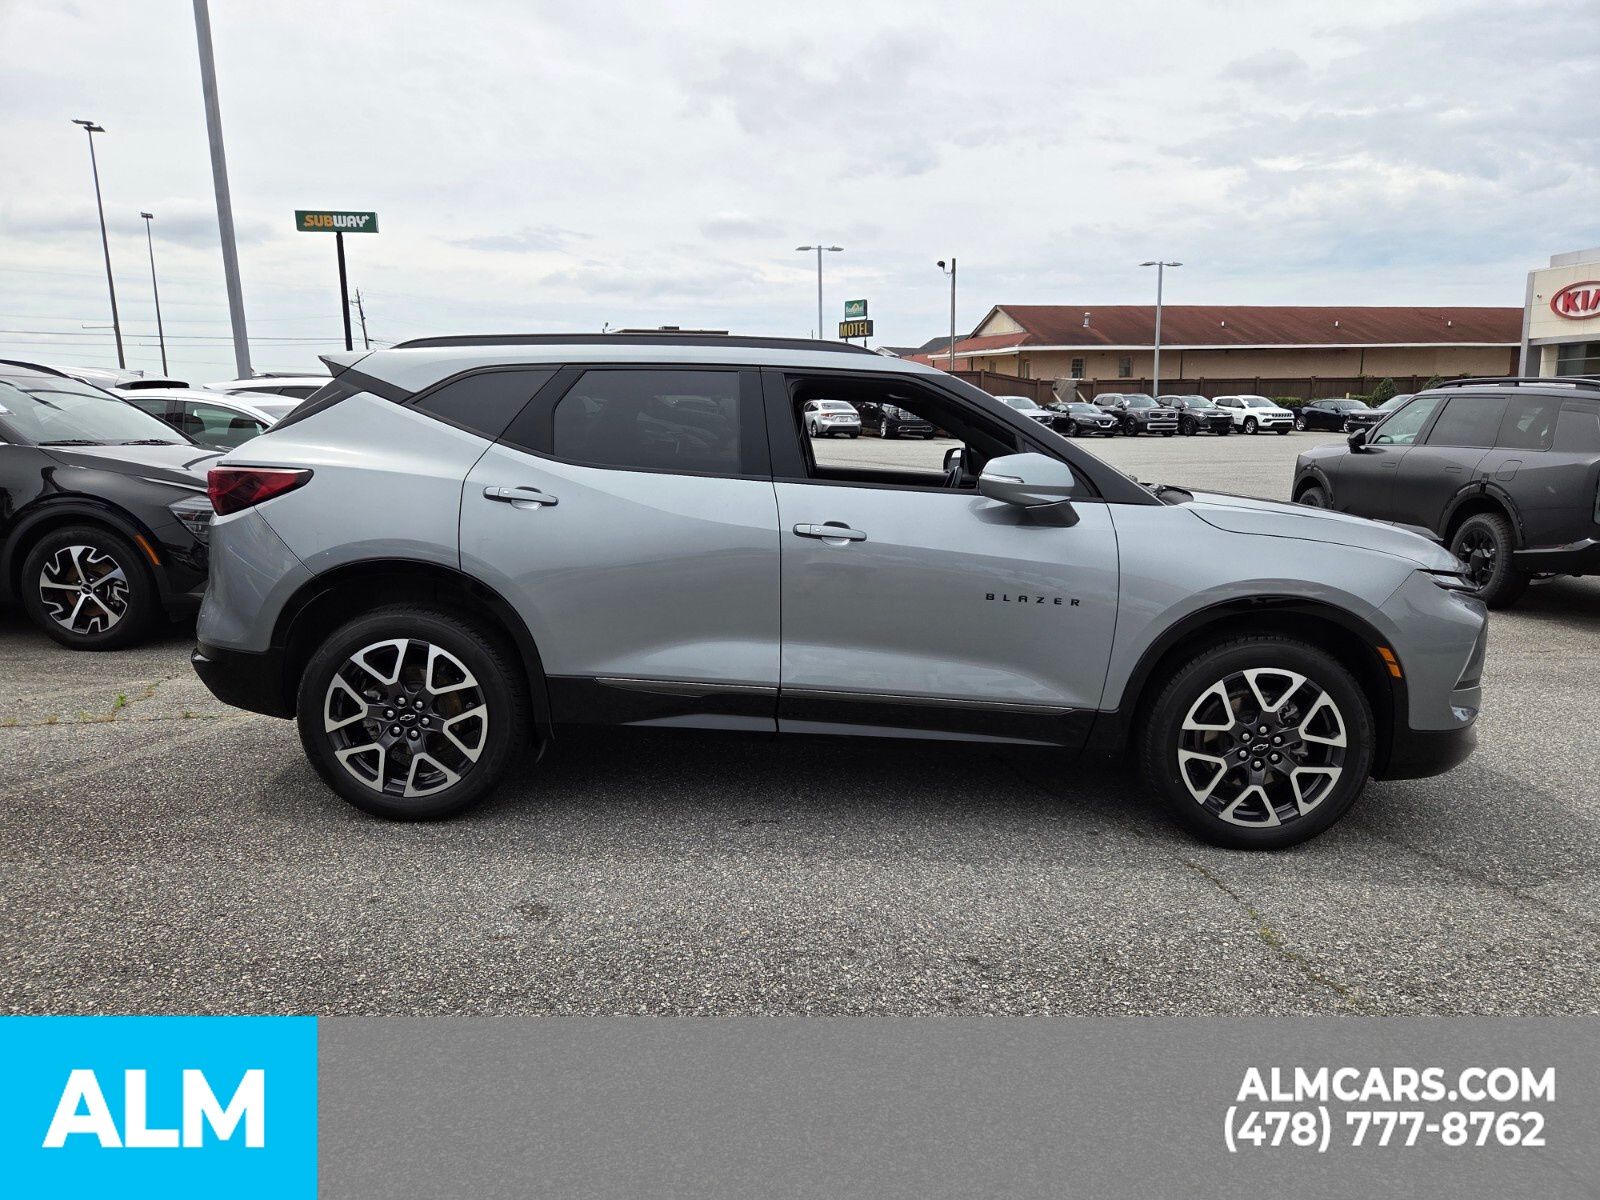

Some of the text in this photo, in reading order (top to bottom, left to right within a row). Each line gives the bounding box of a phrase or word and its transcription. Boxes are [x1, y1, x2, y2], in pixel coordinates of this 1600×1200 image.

[303, 214, 370, 228] SUBWAY
[840, 322, 870, 337] MOTEL
[985, 593, 1081, 607] BLAZER
